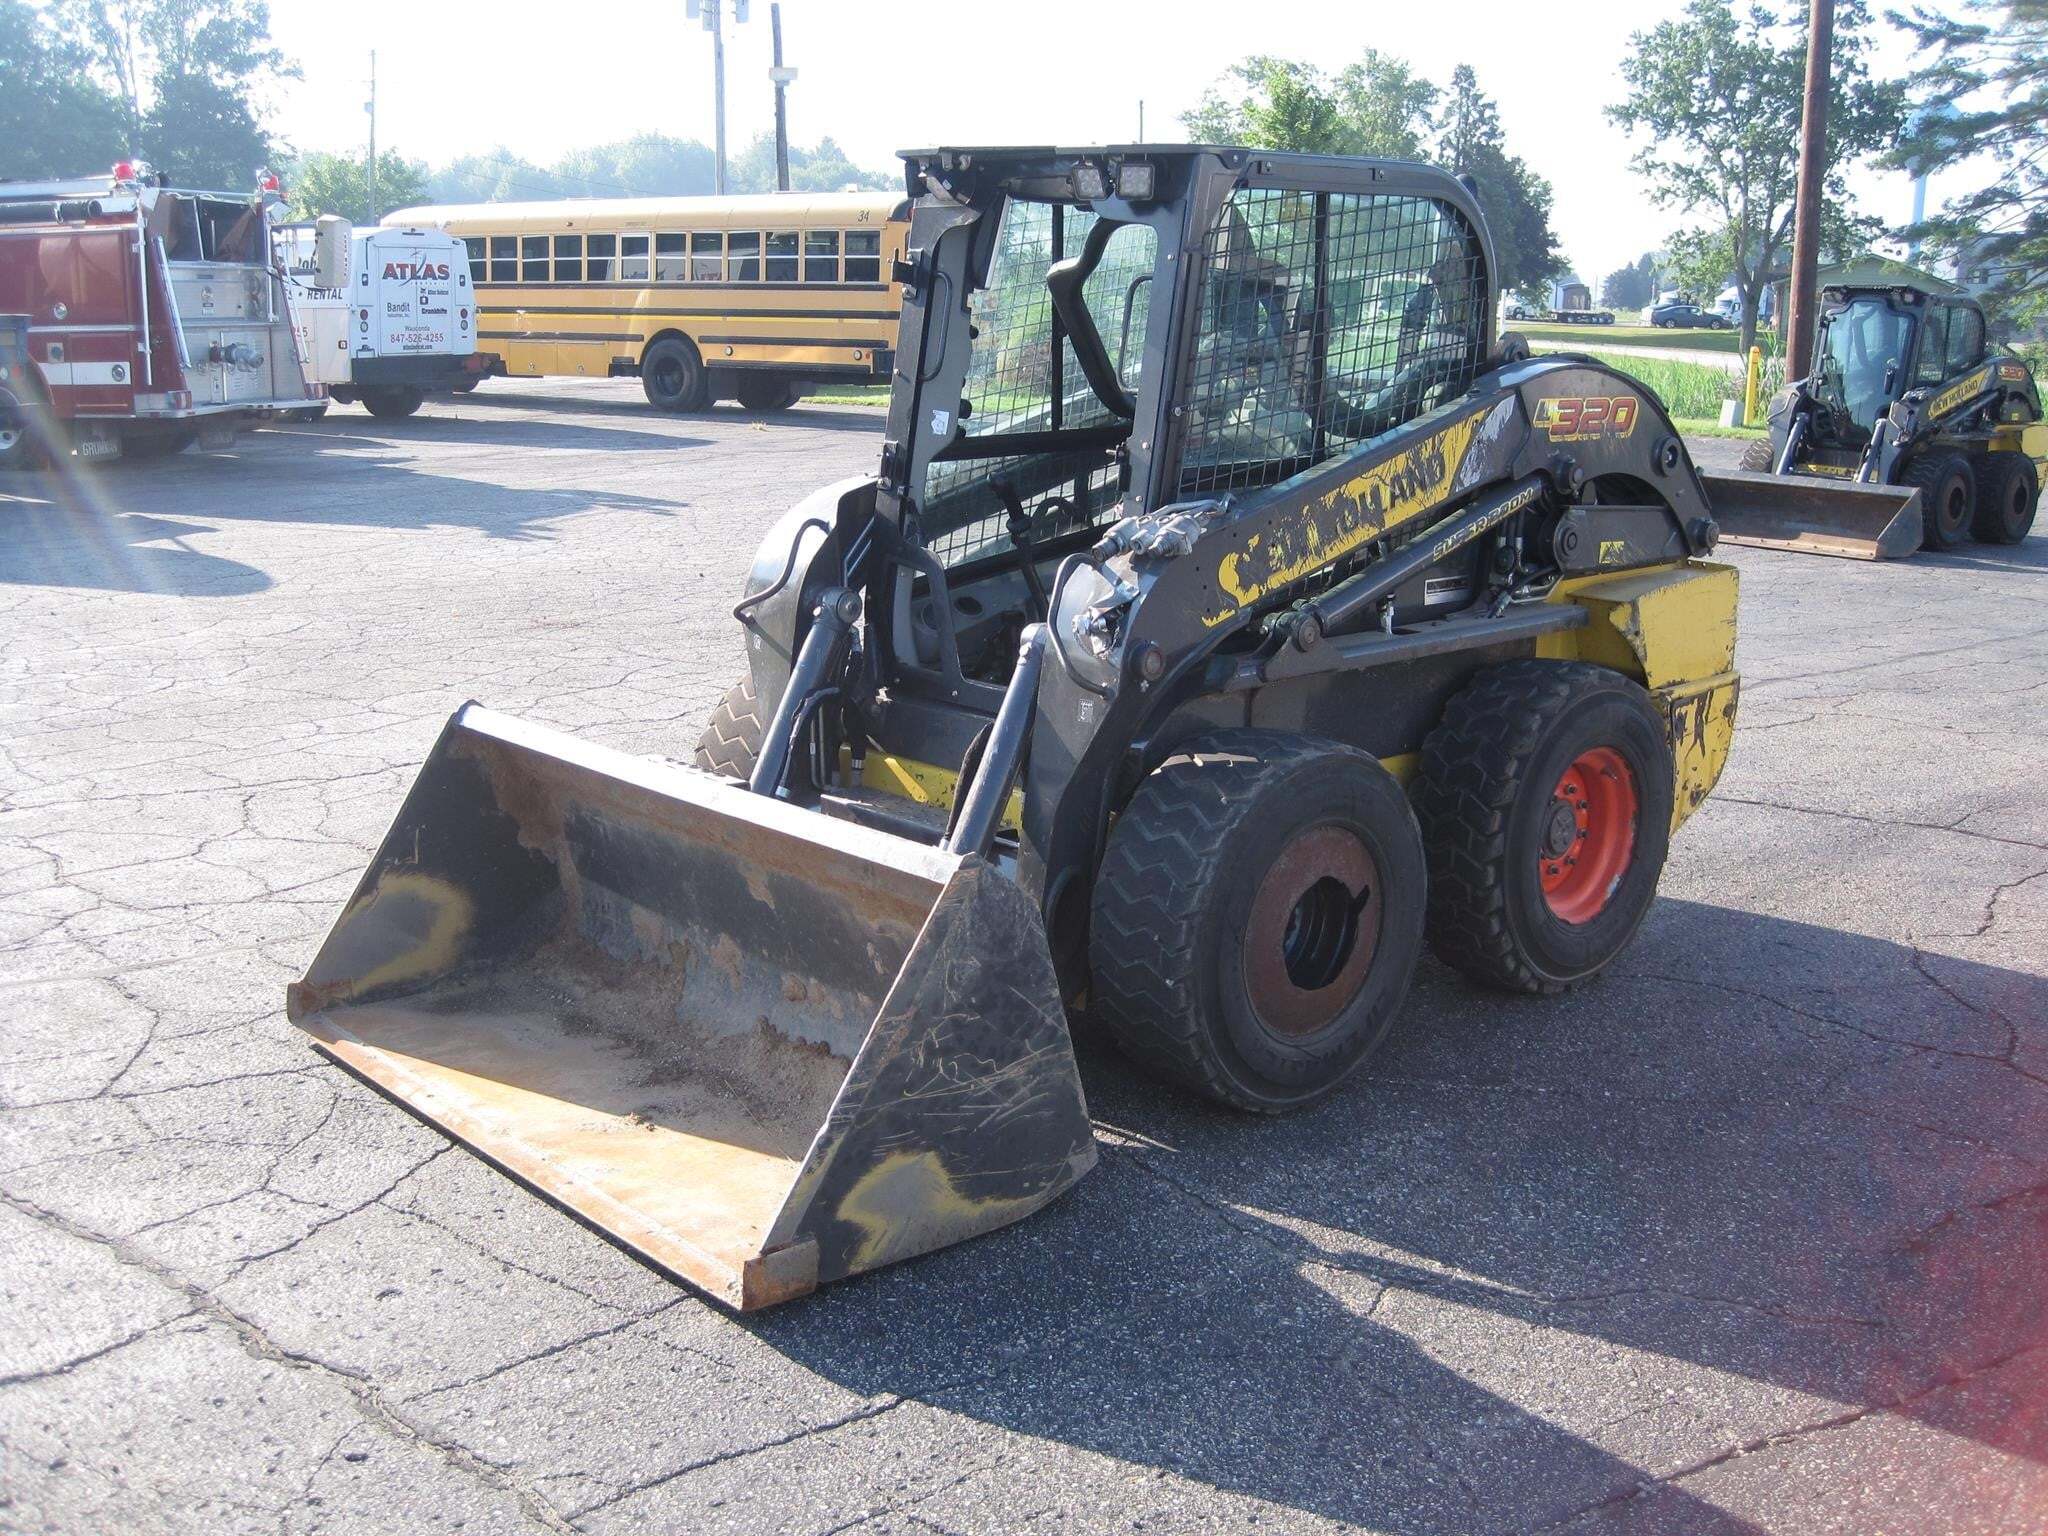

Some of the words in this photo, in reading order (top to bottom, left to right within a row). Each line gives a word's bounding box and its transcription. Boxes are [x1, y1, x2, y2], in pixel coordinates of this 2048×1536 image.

[857, 209, 870, 222] 34
[382, 263, 450, 280] ATLAS
[307, 288, 343, 300] RENTAL
[387, 302, 410, 313] Bandit
[390, 332, 444, 343] 847-526-4255
